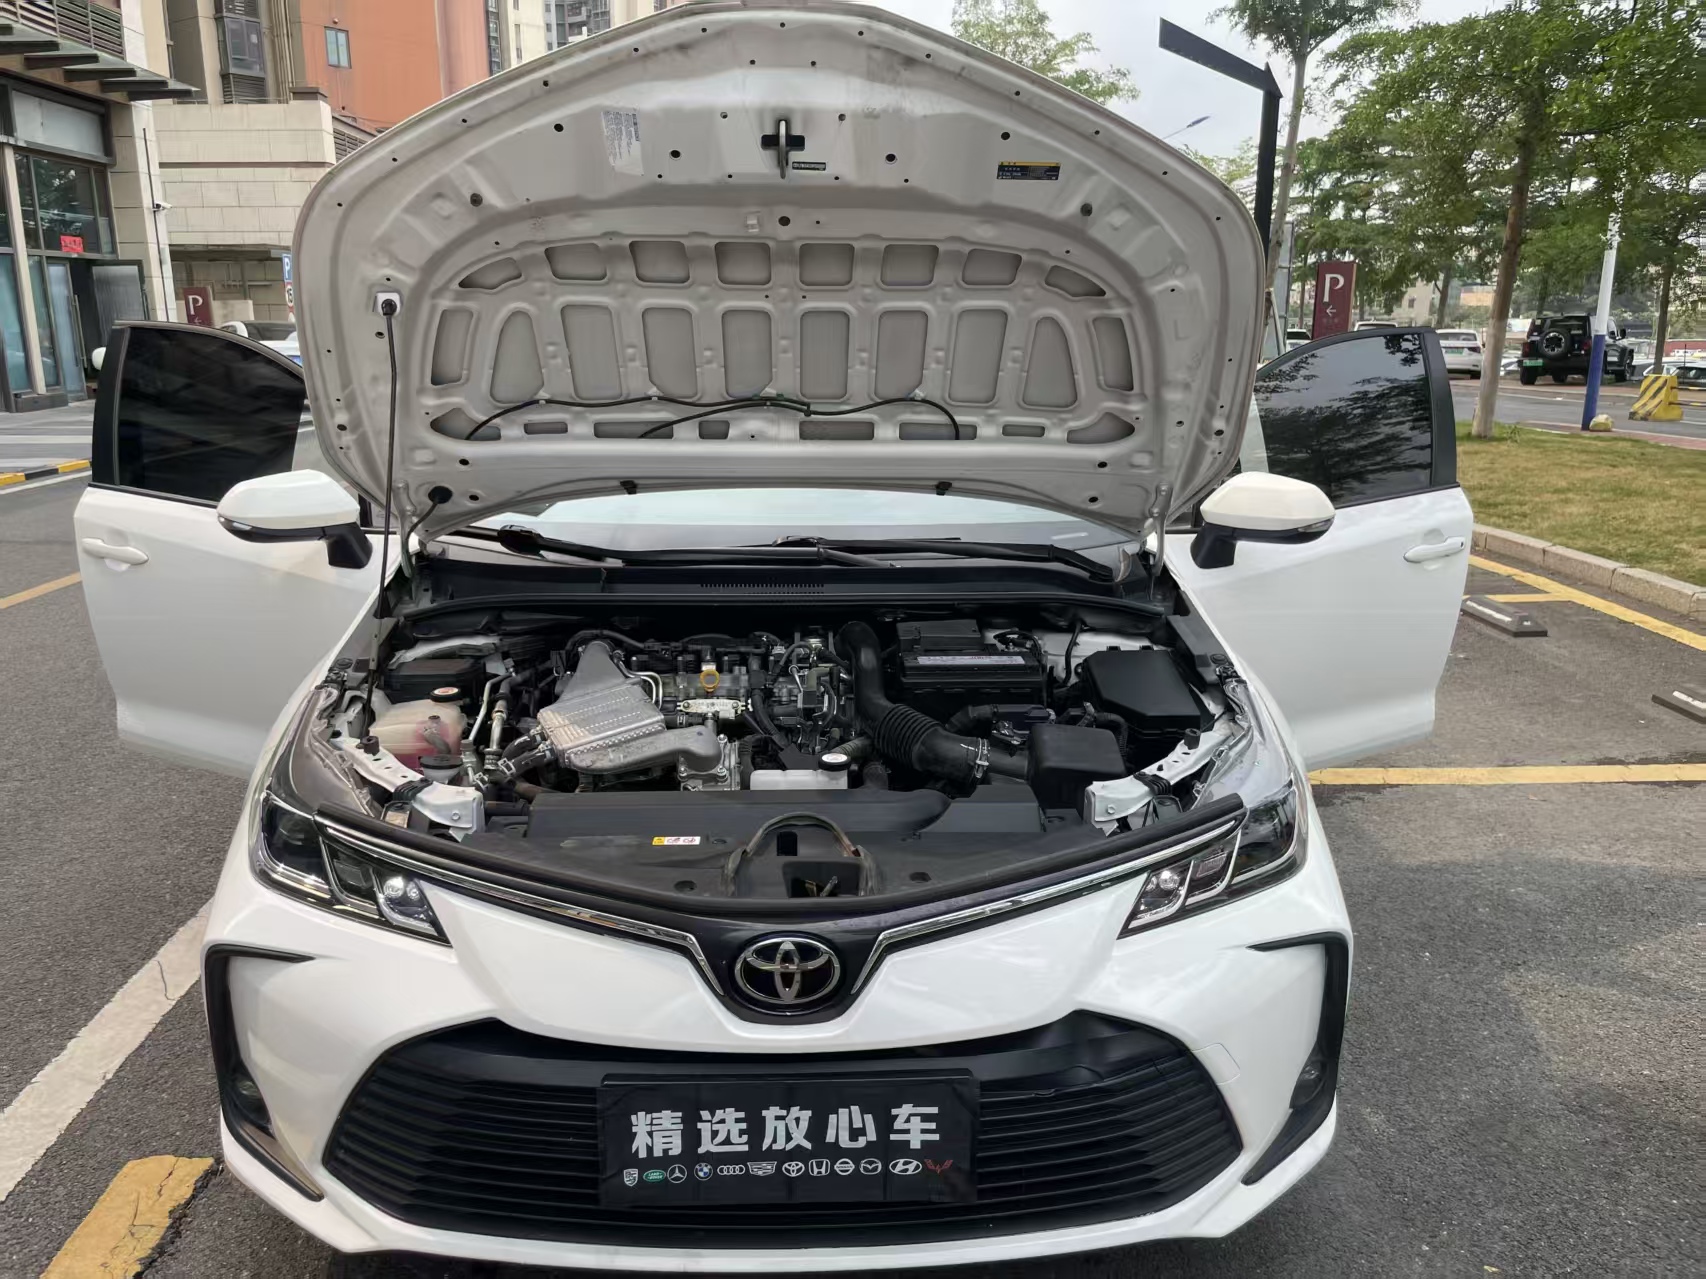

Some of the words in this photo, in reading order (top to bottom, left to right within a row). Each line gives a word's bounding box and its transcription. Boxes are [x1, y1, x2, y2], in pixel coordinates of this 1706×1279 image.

[284, 258, 291, 279] P
[1323, 273, 1345, 303] P
[188, 294, 203, 316] P
[631, 1104, 940, 1158] 精选放心车
